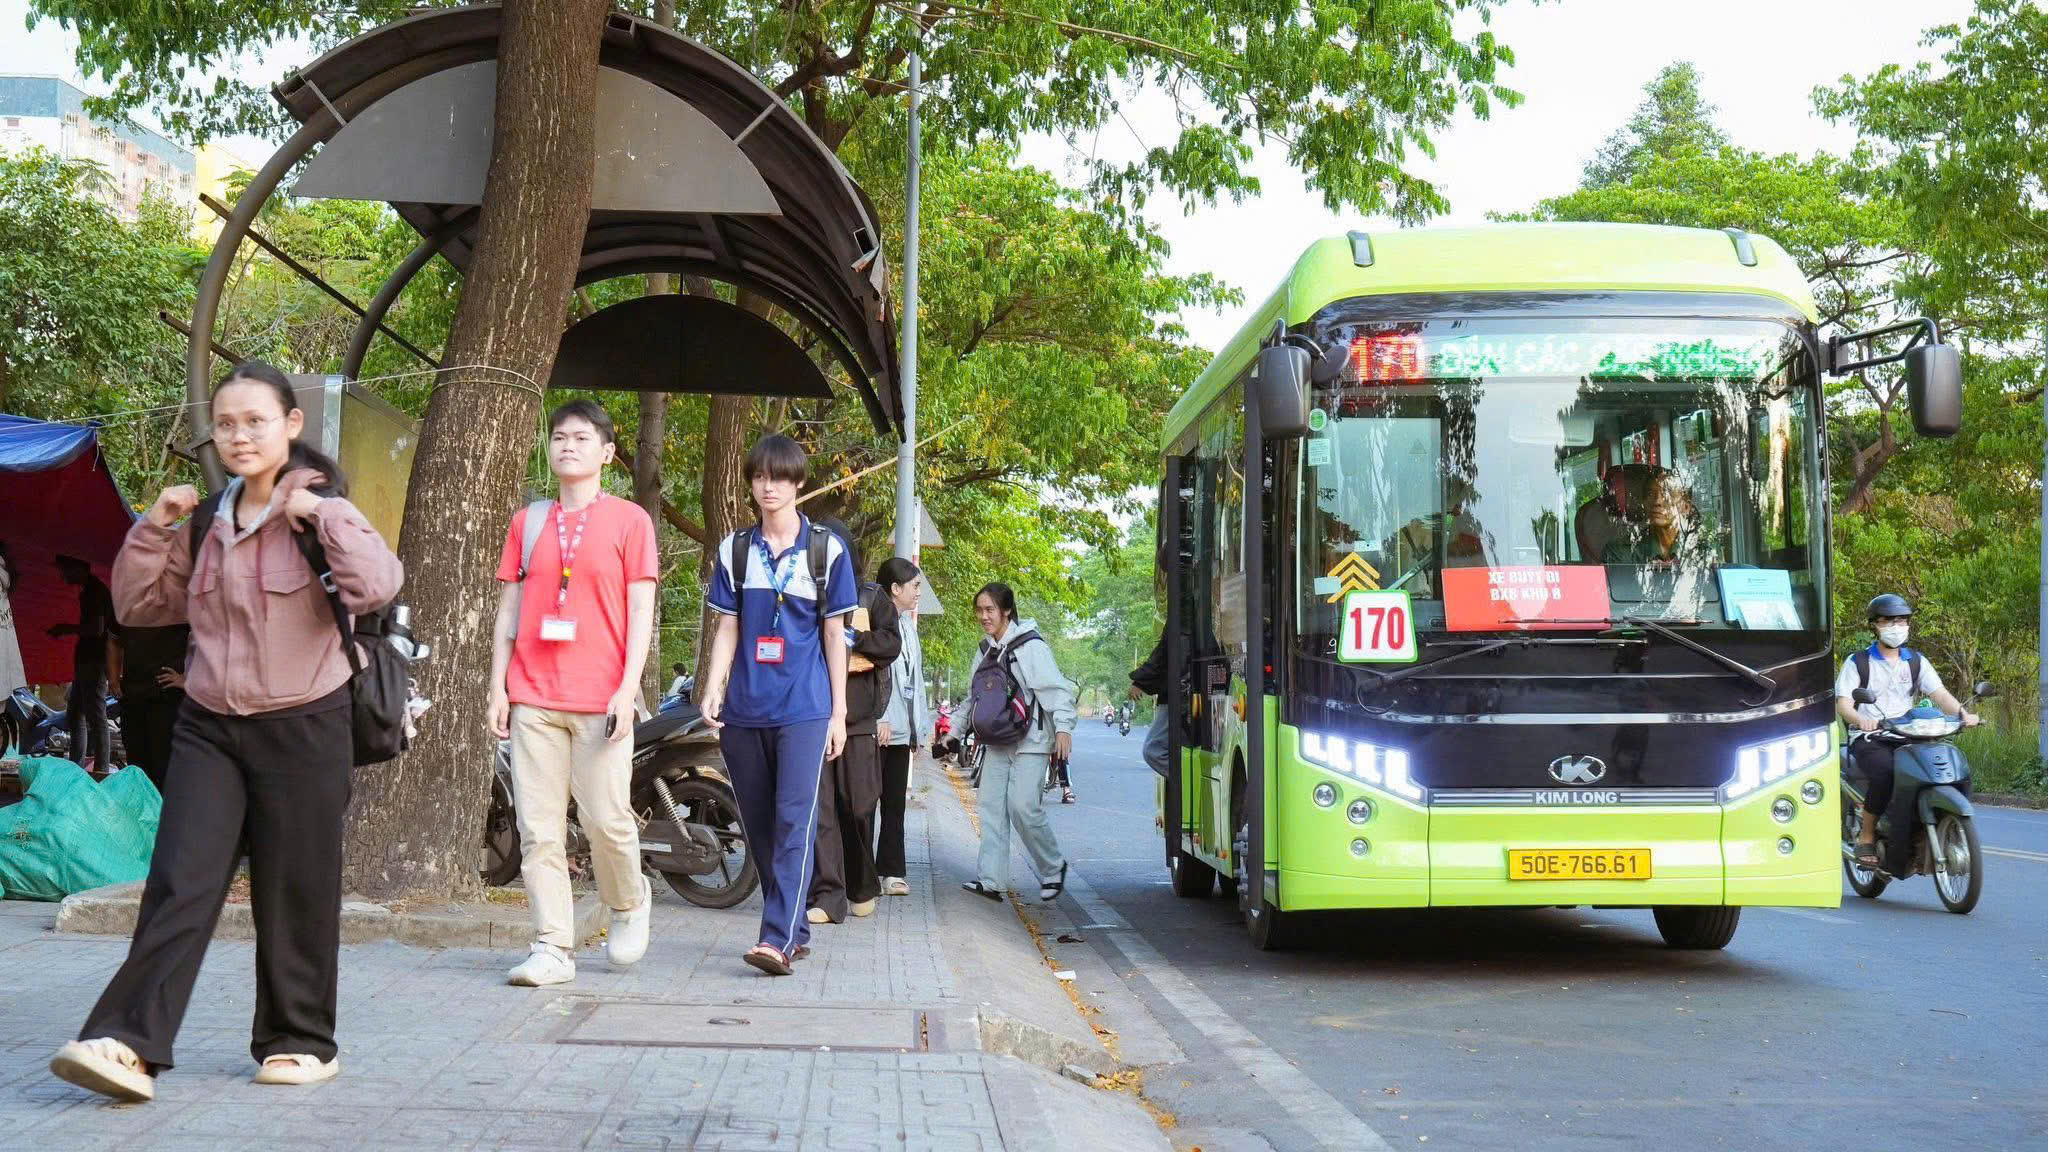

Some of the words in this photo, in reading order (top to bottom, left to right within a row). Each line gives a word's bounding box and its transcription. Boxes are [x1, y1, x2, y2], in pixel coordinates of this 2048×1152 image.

[1351, 336, 1424, 379] 170
[1488, 571, 1505, 584] XE
[1350, 607, 1405, 651] 170
[1535, 792, 1569, 804] KIM
[1573, 792, 1618, 804] LONG
[1521, 855, 1637, 874] 50E-766.61
